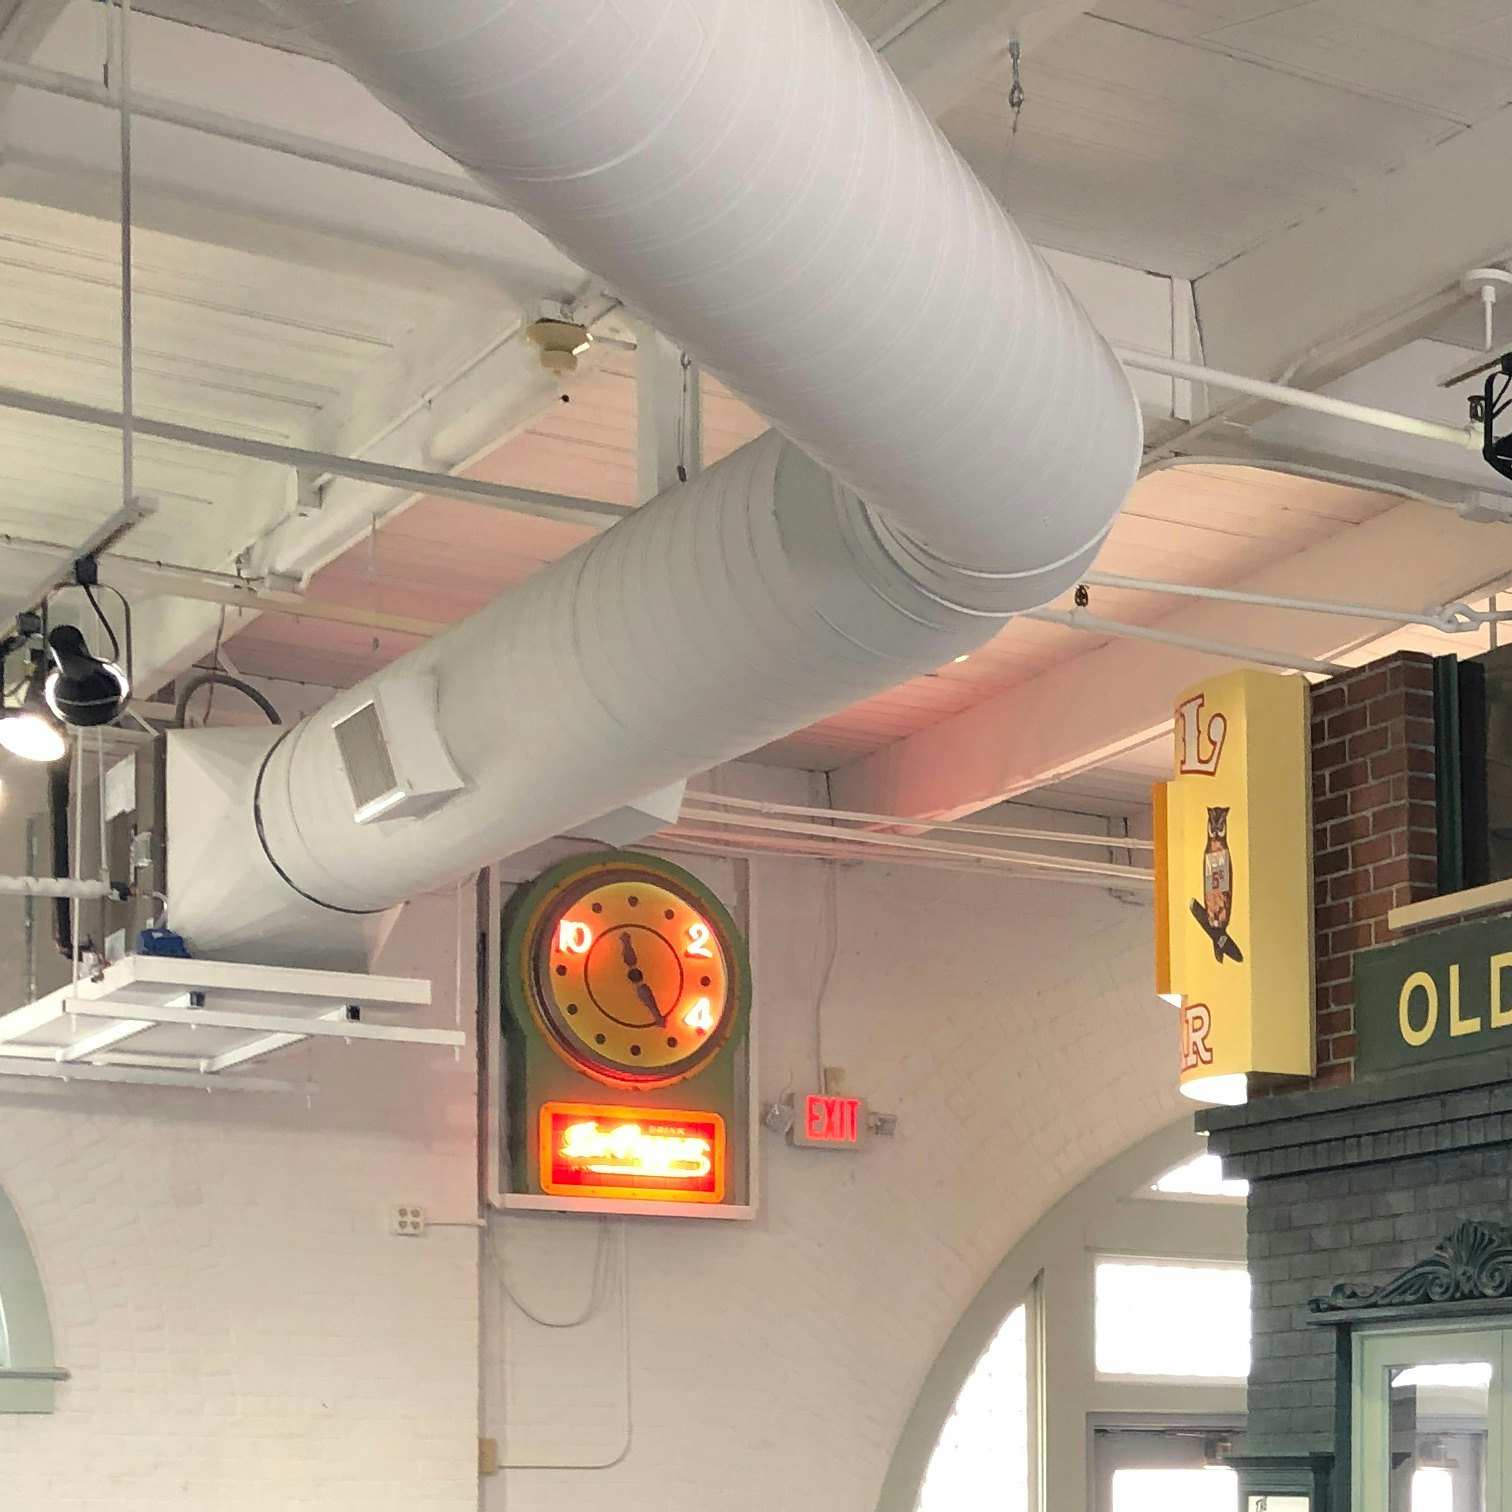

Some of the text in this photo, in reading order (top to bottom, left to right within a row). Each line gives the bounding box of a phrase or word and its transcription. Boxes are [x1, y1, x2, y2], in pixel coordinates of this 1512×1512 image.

[558, 919, 592, 953] 10
[685, 923, 713, 958] 2
[684, 996, 714, 1034] 4
[806, 1095, 860, 1143] EXIT
